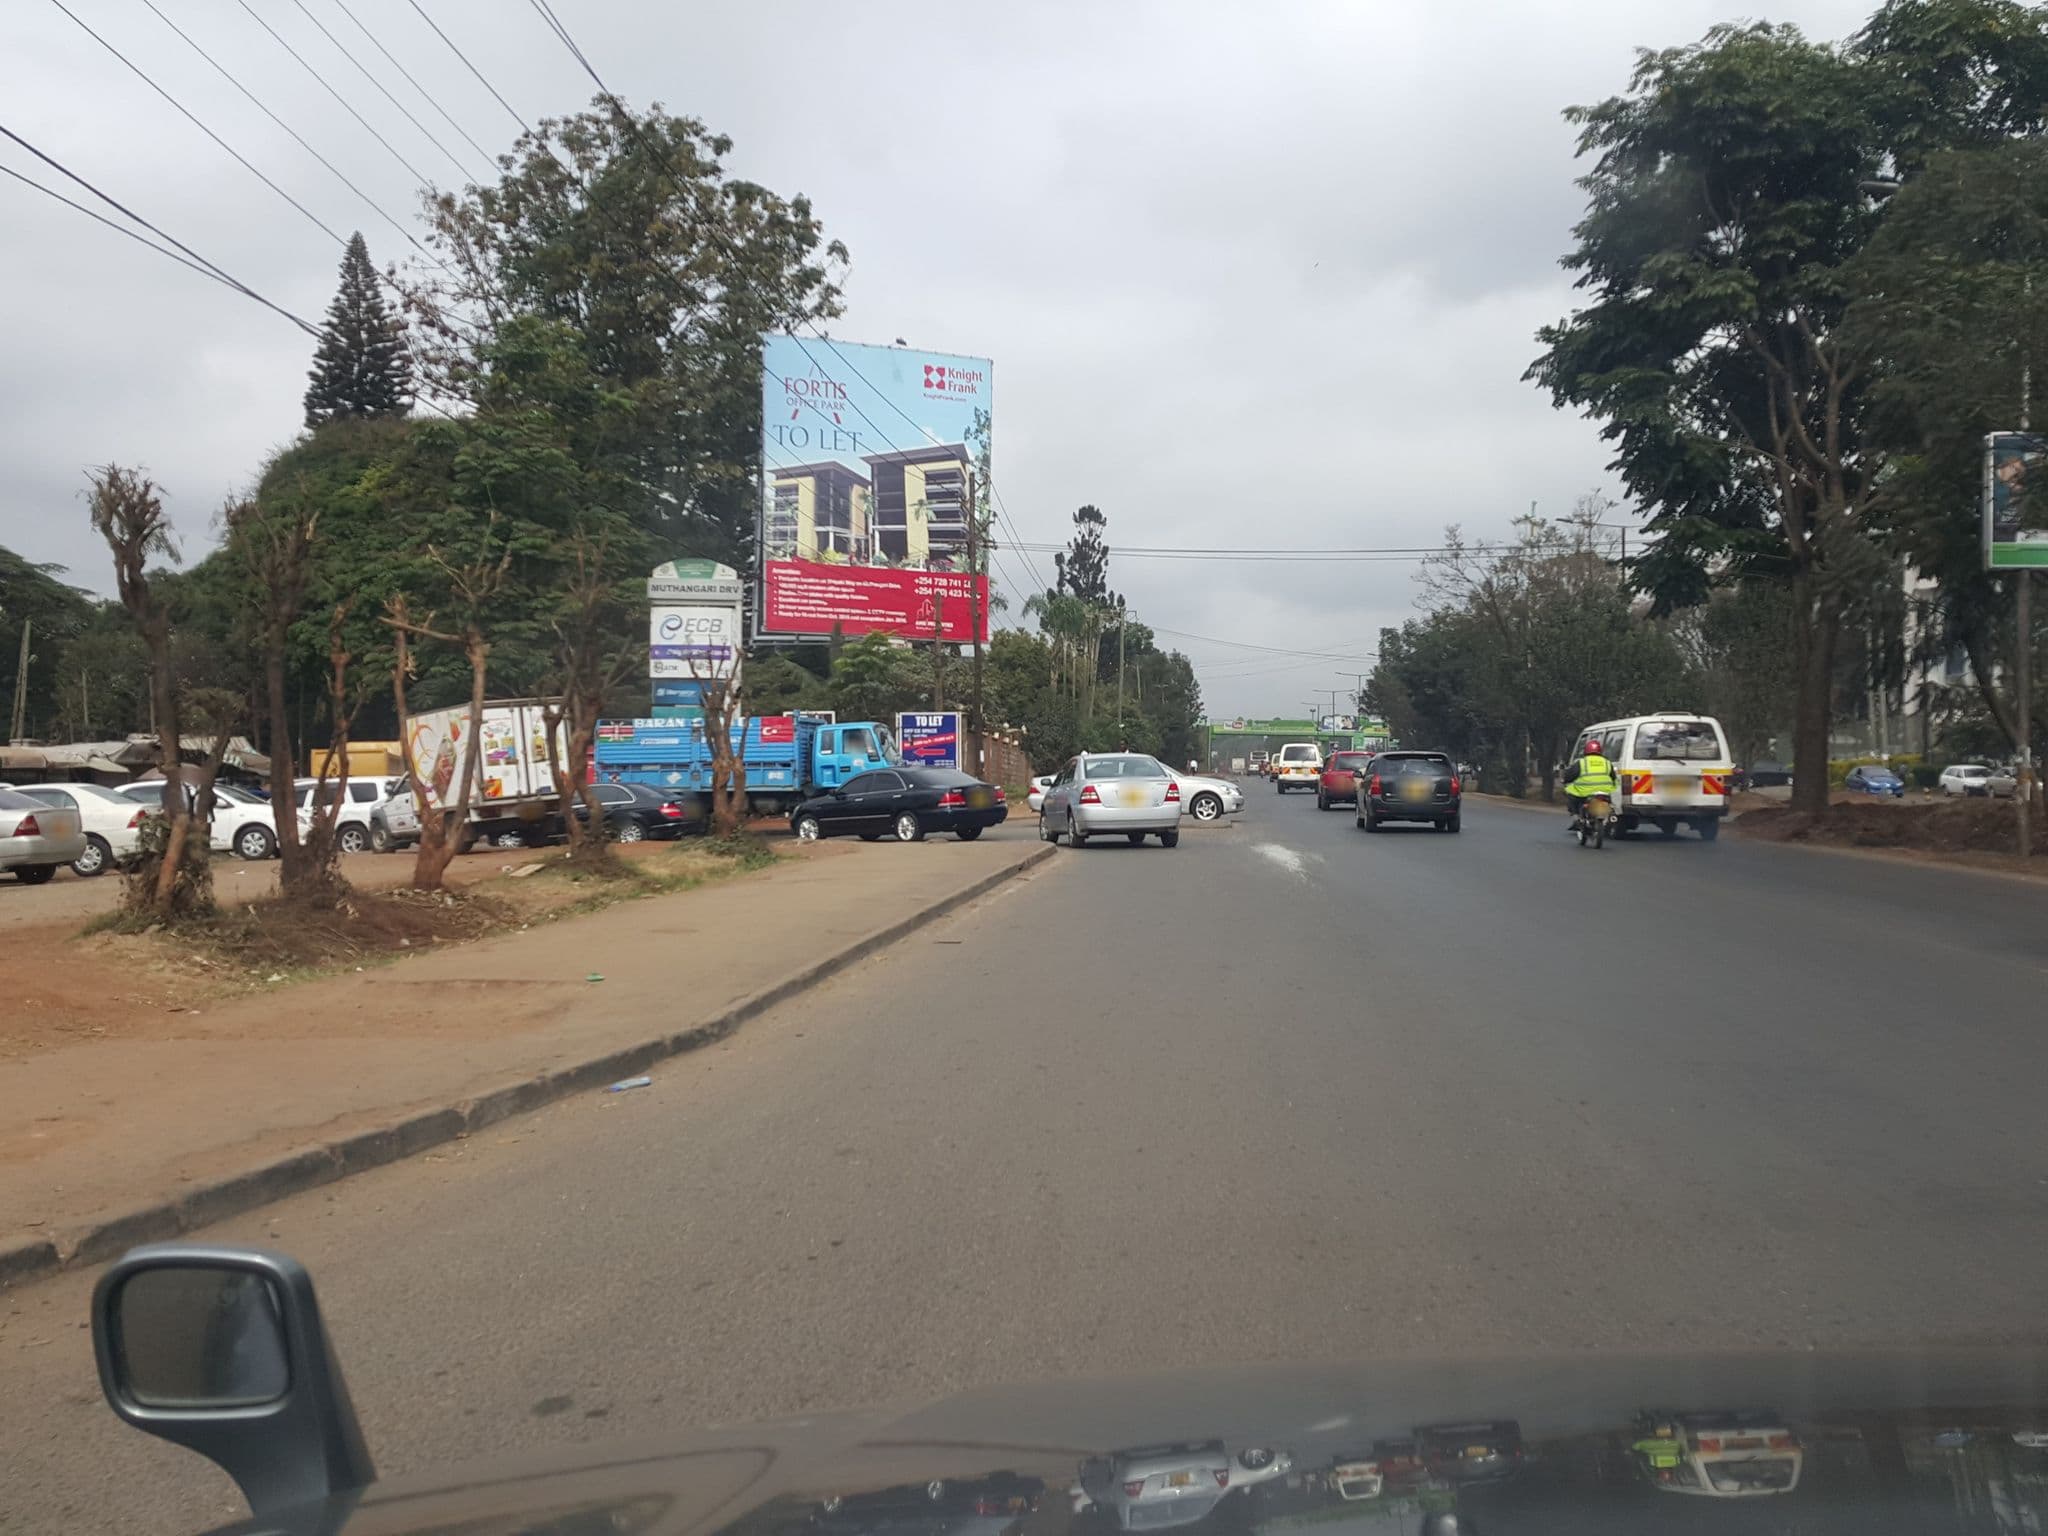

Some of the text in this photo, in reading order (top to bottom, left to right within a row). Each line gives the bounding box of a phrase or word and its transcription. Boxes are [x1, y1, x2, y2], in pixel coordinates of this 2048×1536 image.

[948, 367, 984, 383] Knight
[785, 377, 847, 401] FORTIS
[948, 381, 977, 394] Frank
[786, 397, 847, 412] OFFICE PARK
[773, 424, 863, 452] TO LET
[914, 576, 932, 585] +254
[651, 584, 740, 594] MUTHANGARI DRV
[684, 618, 722, 633] ECB
[915, 715, 944, 727] TO LET
